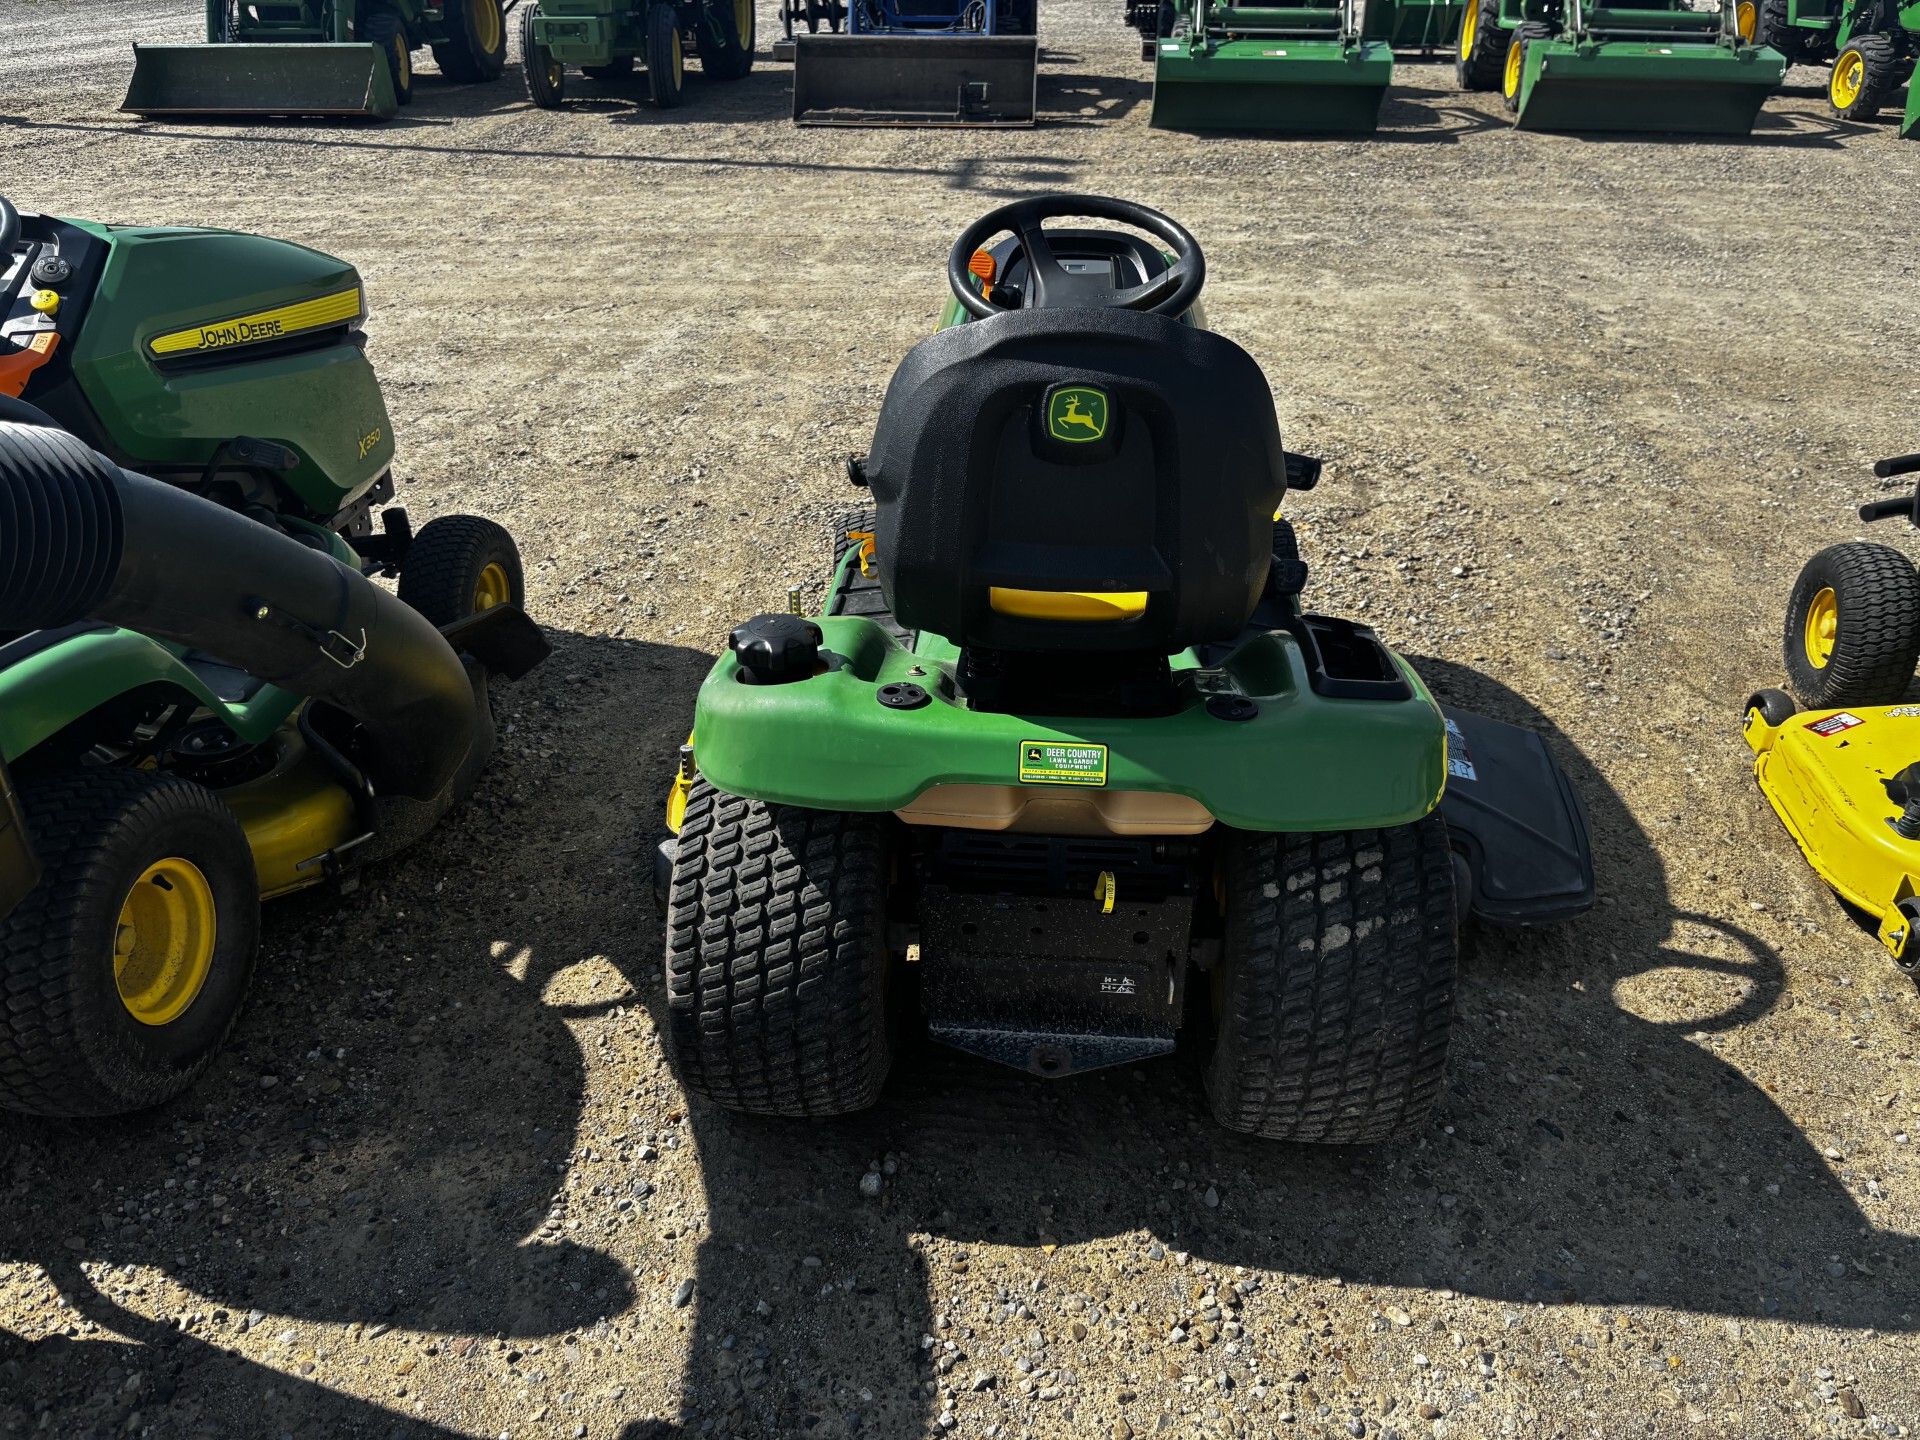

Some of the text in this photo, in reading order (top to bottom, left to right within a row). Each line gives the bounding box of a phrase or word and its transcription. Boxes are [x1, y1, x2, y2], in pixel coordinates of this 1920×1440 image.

[198, 320, 283, 347] JOHN DEERE
[358, 427, 381, 460] X350
[1046, 747, 1102, 759] DEER COUNTRY
